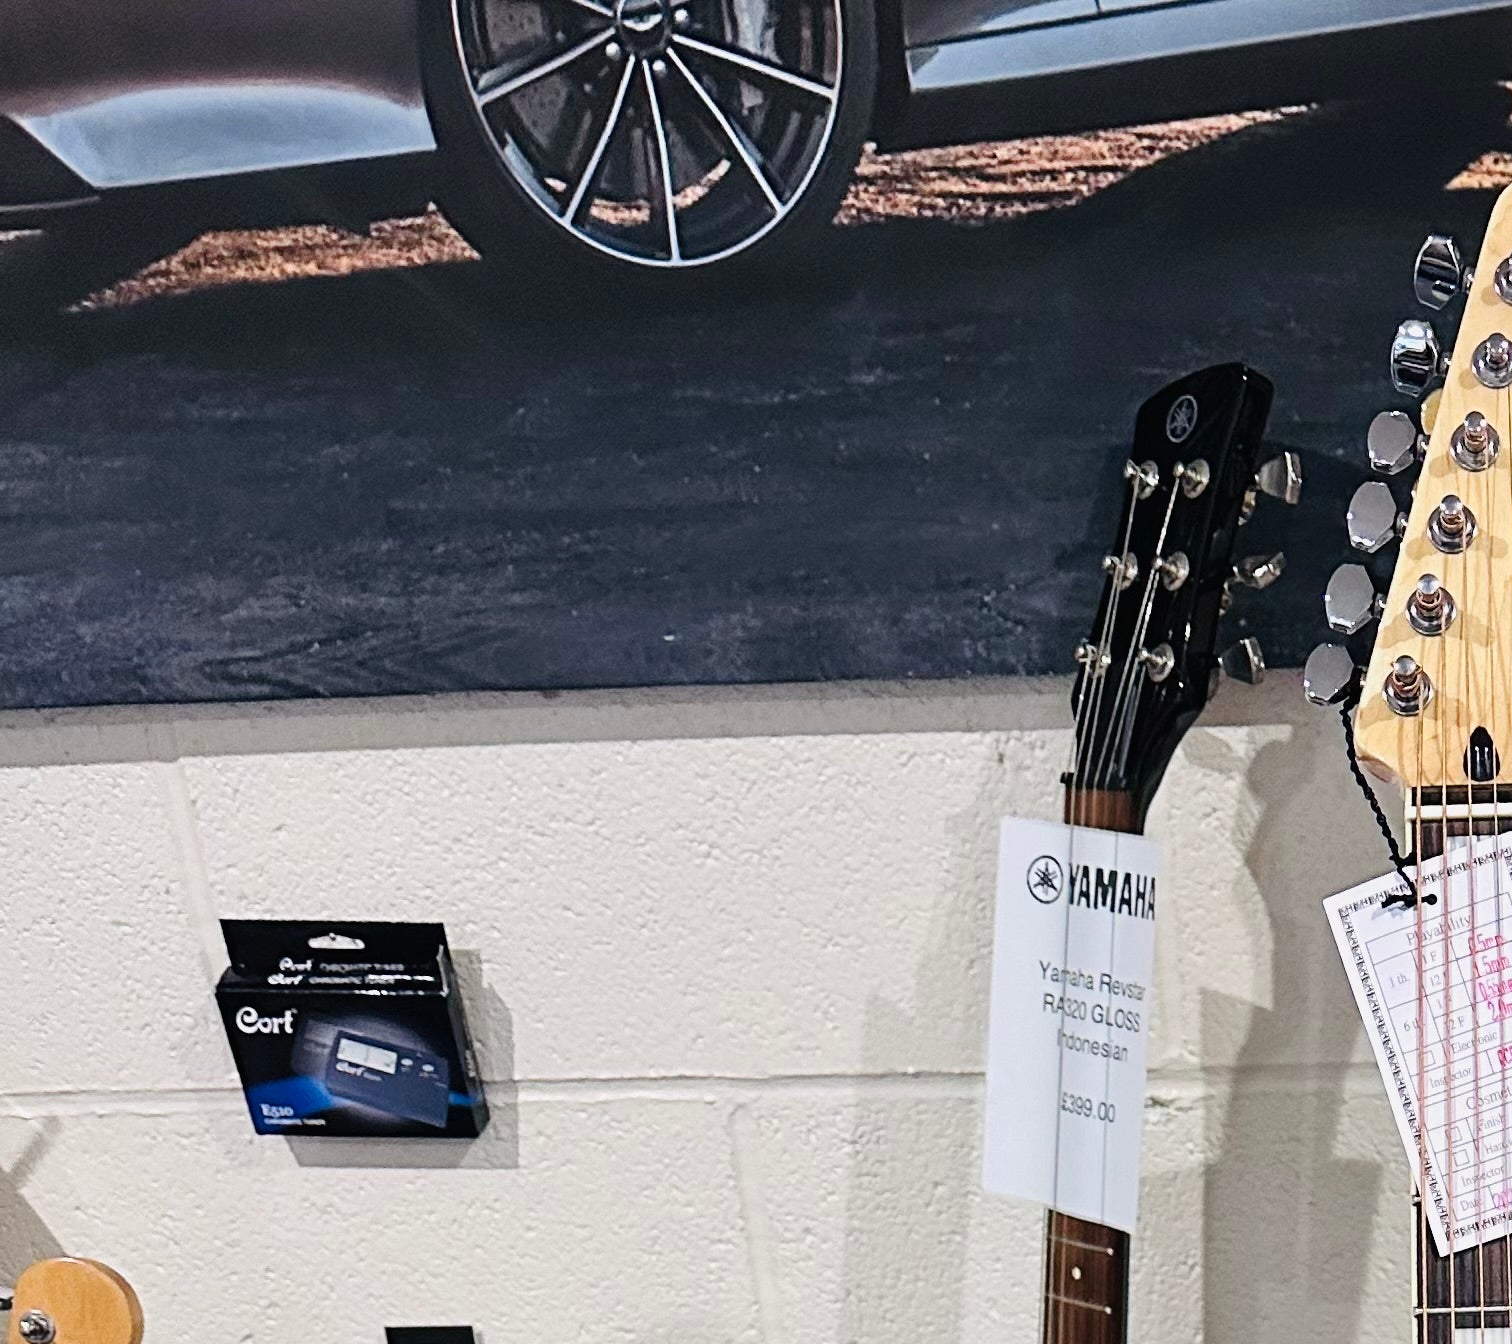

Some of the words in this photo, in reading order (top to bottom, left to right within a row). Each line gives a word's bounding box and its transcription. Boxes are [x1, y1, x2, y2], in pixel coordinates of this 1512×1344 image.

[1068, 862, 1156, 921] YAMAHA
[1039, 961, 1094, 992] Yamaha
[236, 1006, 298, 1034] Cort
[1092, 1004, 1140, 1032] GLOSS
[1057, 1028, 1128, 1063] Indonesian
[1451, 1031, 1498, 1054] Electonic
[1430, 1067, 1472, 1088] Insector
[1062, 1093, 1115, 1123] £399.00
